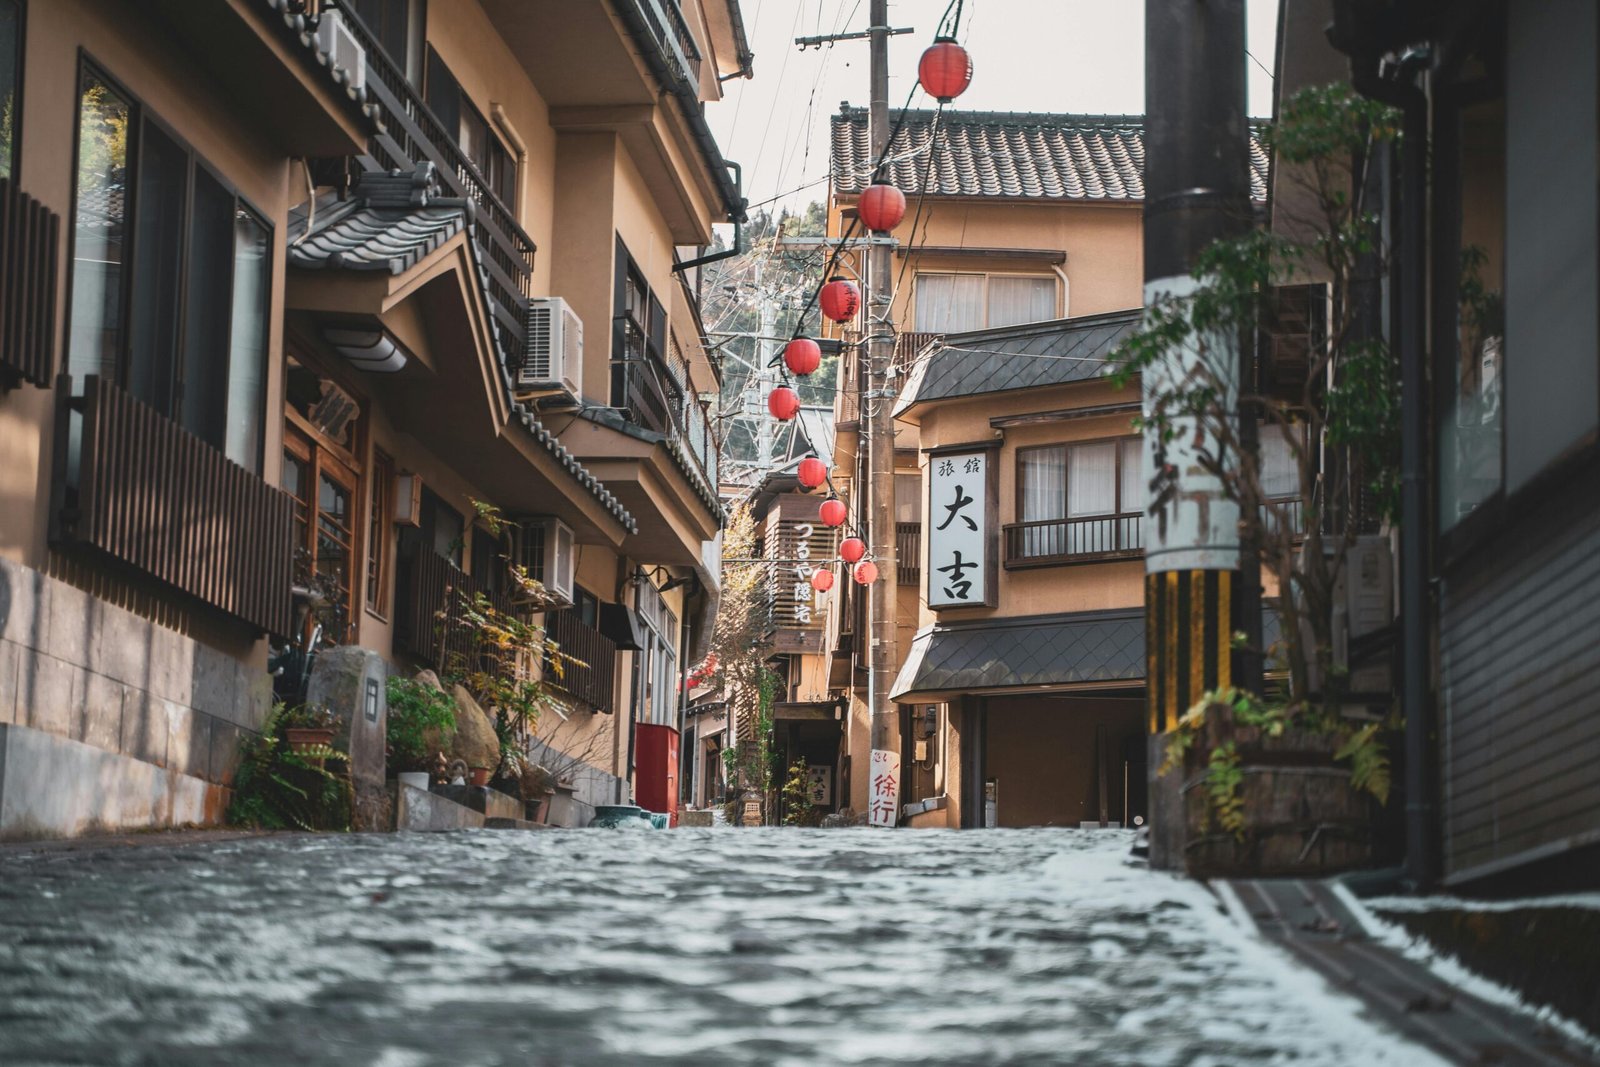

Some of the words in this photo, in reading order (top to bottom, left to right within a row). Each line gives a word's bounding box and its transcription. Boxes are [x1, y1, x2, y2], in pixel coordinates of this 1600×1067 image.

[938, 457, 981, 477] 旅館
[793, 523, 814, 624] つるや隠宅
[936, 485, 979, 600] 大吉
[873, 774, 897, 823] 徐行
